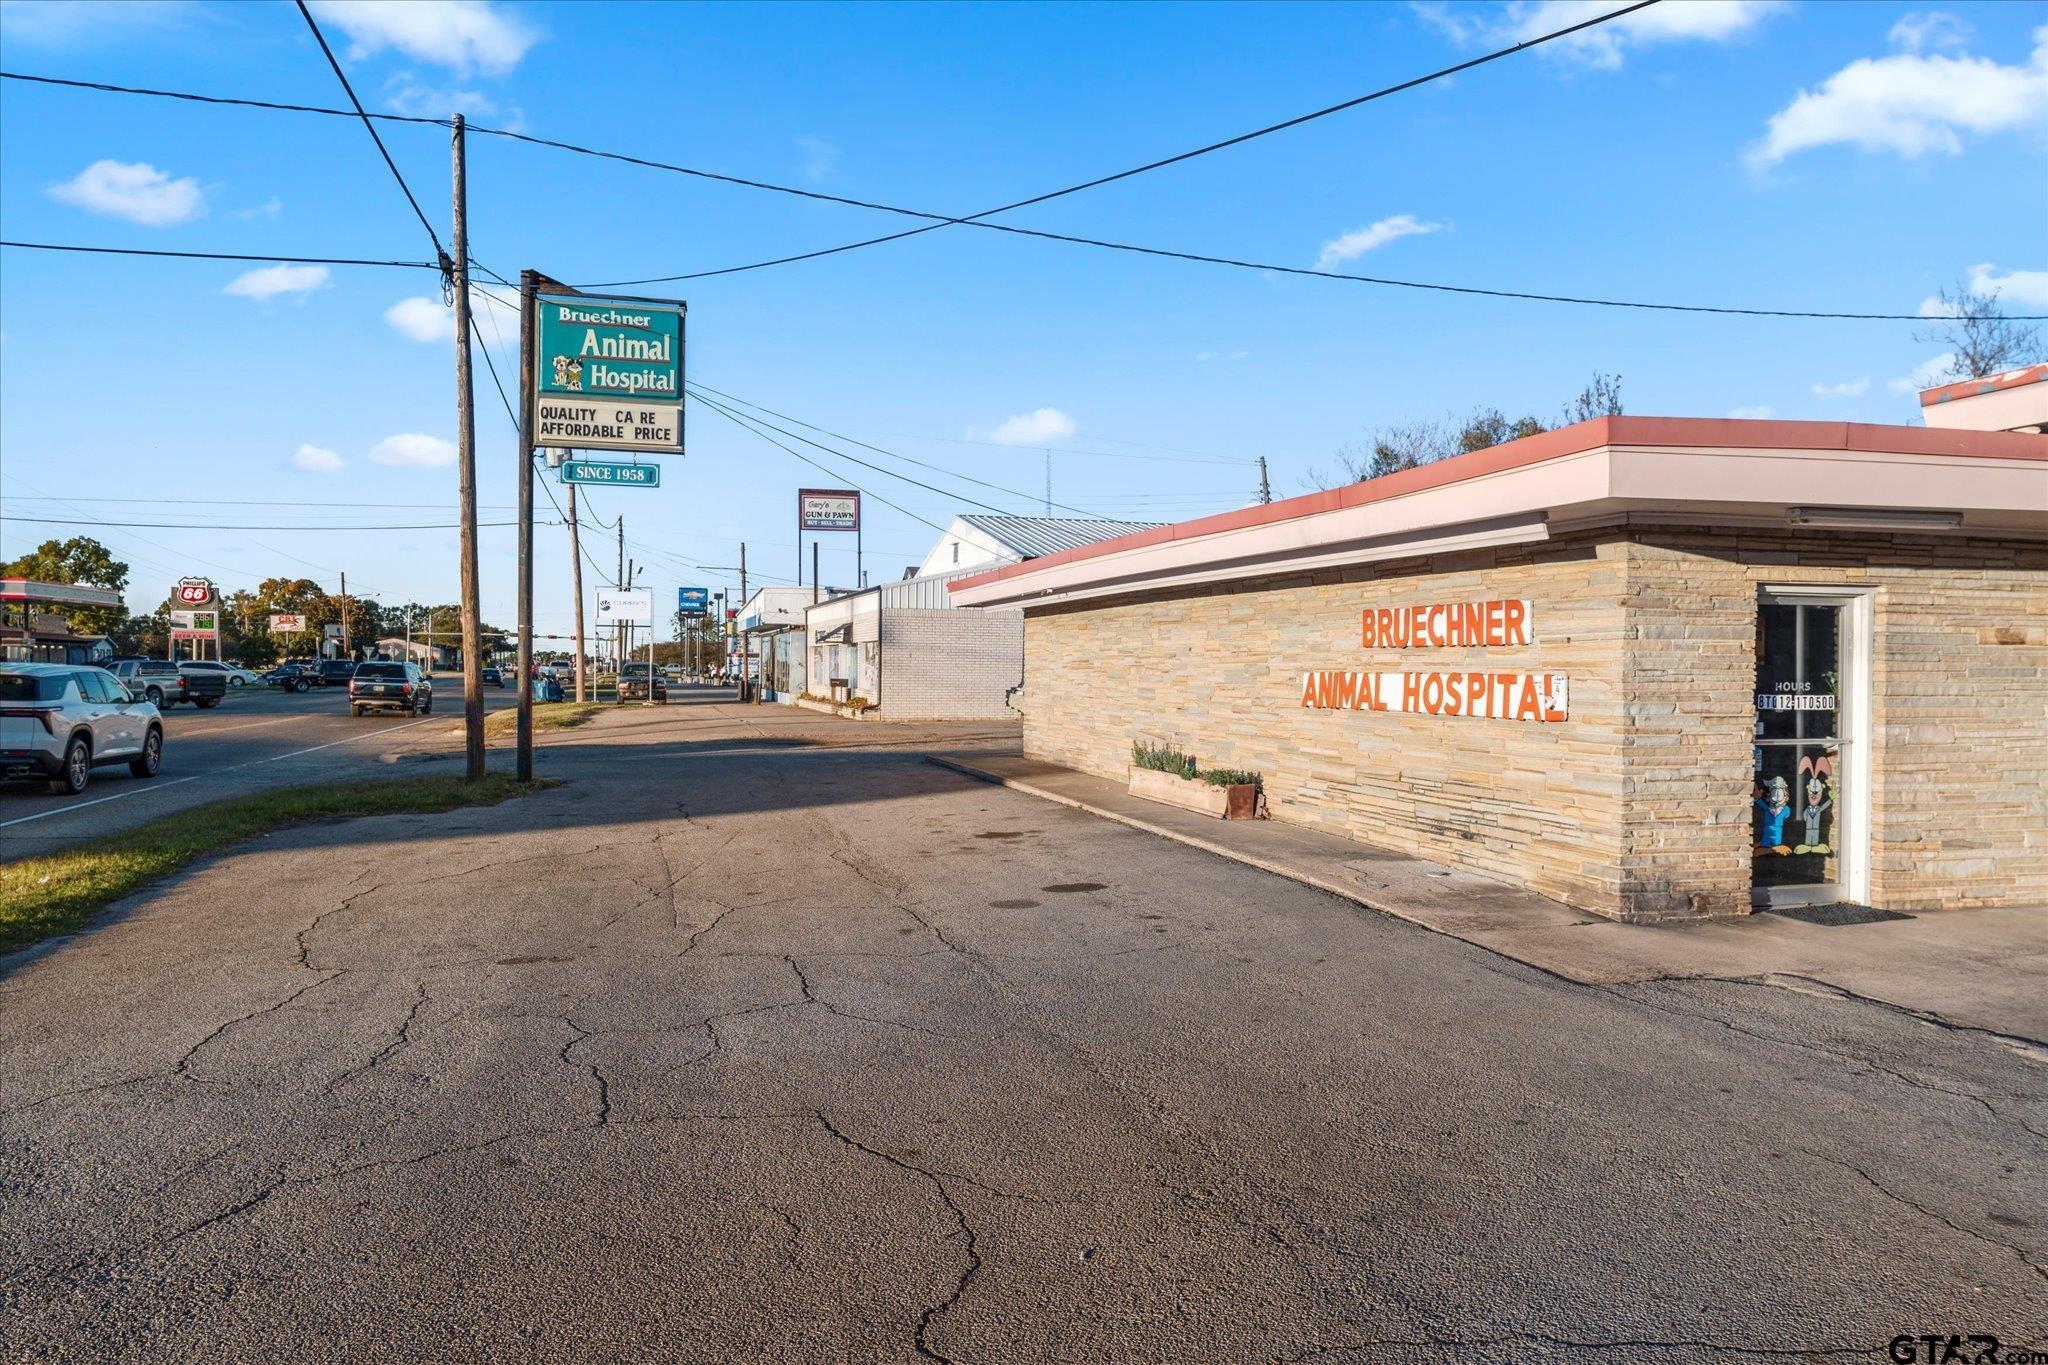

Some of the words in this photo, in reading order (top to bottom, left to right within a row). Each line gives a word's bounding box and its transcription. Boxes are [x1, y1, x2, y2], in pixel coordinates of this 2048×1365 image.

[559, 307, 651, 327] Bruechner
[579, 328, 670, 361] Animal
[591, 364, 675, 394] Hospital
[540, 406, 597, 421] QUALITY
[540, 422, 624, 439] AFFORDABLE
[634, 427, 671, 441] PRICE
[576, 466, 612, 480] SINCE
[616, 468, 645, 481] 1958
[824, 511, 831, 519] &
[832, 511, 854, 519] PAWN
[183, 588, 204, 599] 66
[1362, 600, 1526, 649] BRUECHNER
[1775, 681, 1811, 692] HOURS
[1301, 671, 1388, 711] ANIMAL
[1402, 671, 1565, 722] HOSPITAL
